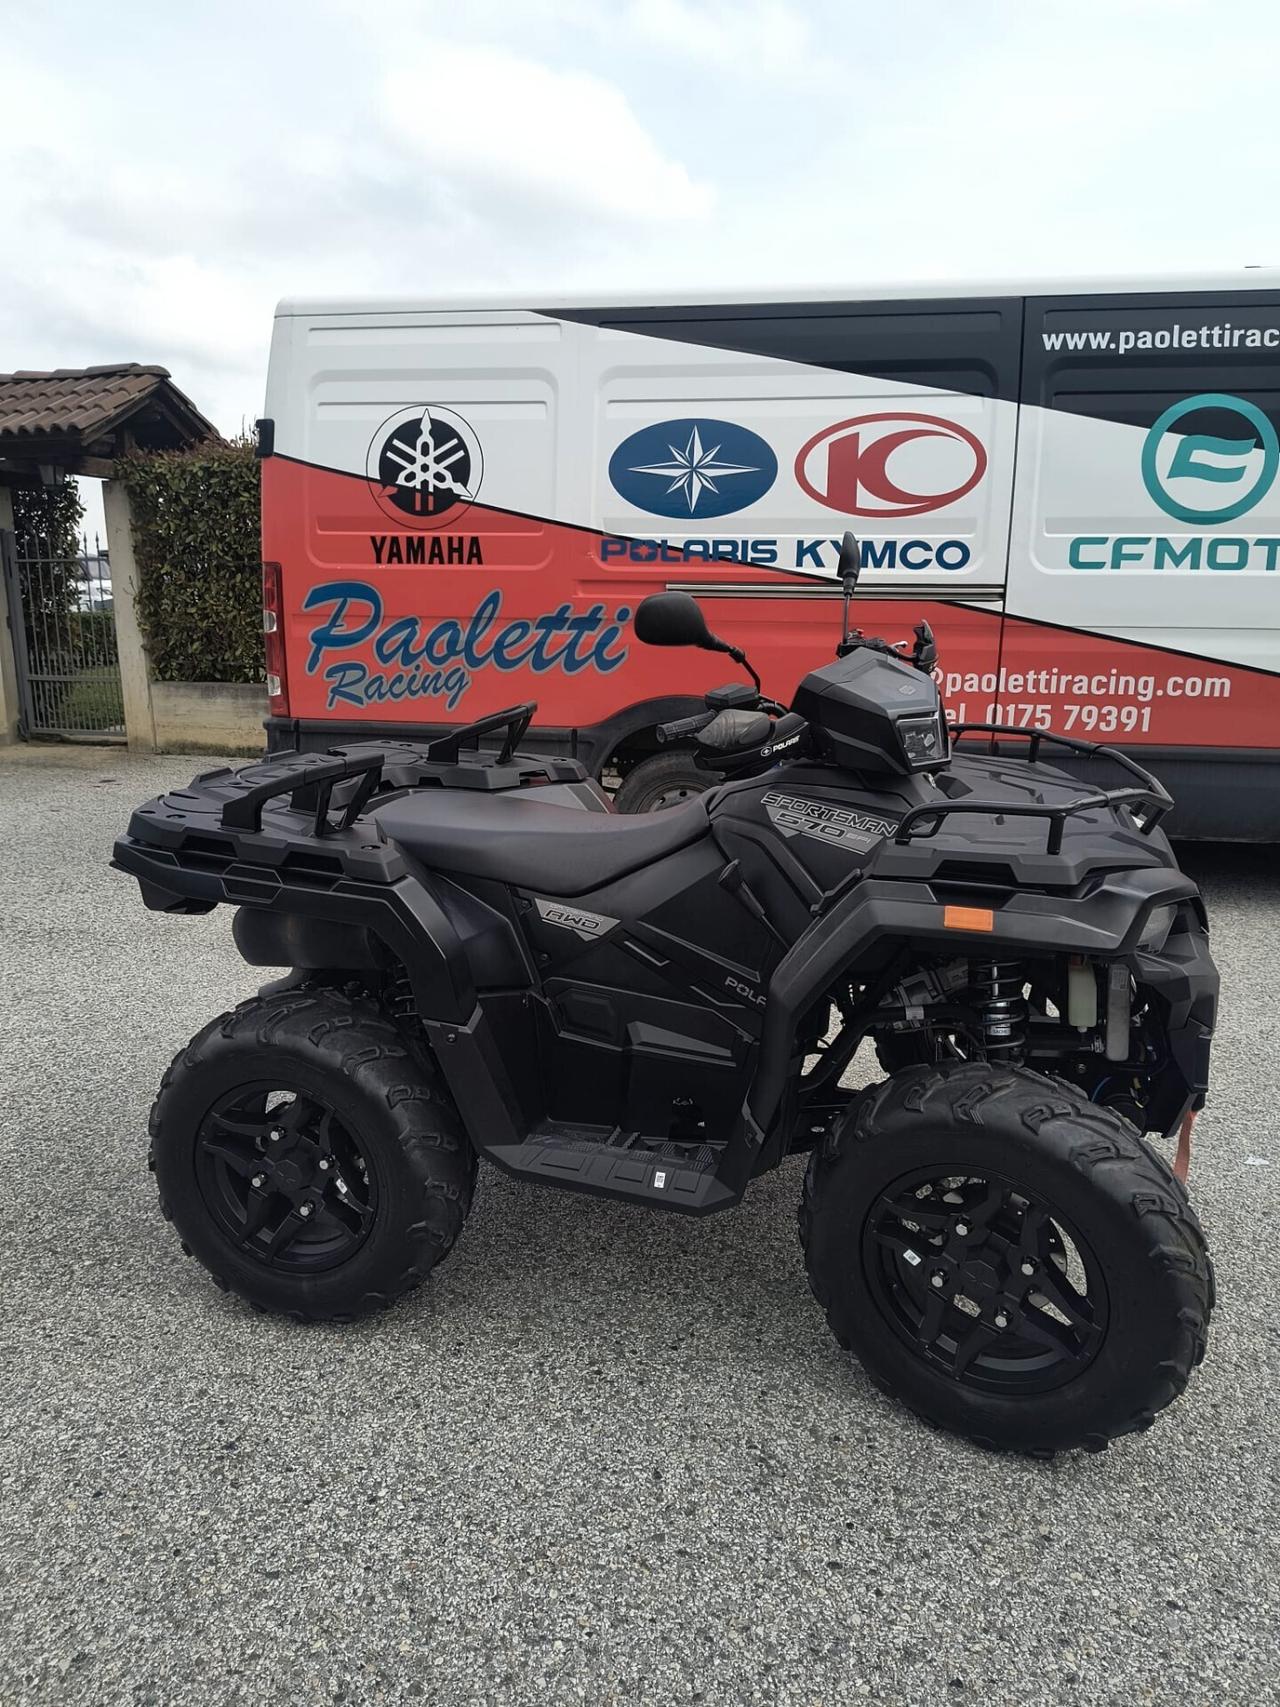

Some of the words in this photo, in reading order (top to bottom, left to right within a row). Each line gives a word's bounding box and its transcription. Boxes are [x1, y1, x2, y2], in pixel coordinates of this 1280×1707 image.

[1042, 323, 1280, 355] www.paolettirac
[371, 536, 483, 566] YAMAHA
[601, 539, 778, 564] POLARIS
[1069, 536, 1280, 571] CFMOT
[302, 579, 634, 675] Paoletti
[324, 662, 472, 711] Racing
[945, 702, 966, 724] el
[986, 702, 1052, 731] 0175
[1064, 704, 1152, 732] 79391
[772, 734, 801, 753] POLARIS
[761, 791, 899, 838] SPORTSMAN
[775, 811, 847, 839] 570
[545, 909, 601, 930] AWD
